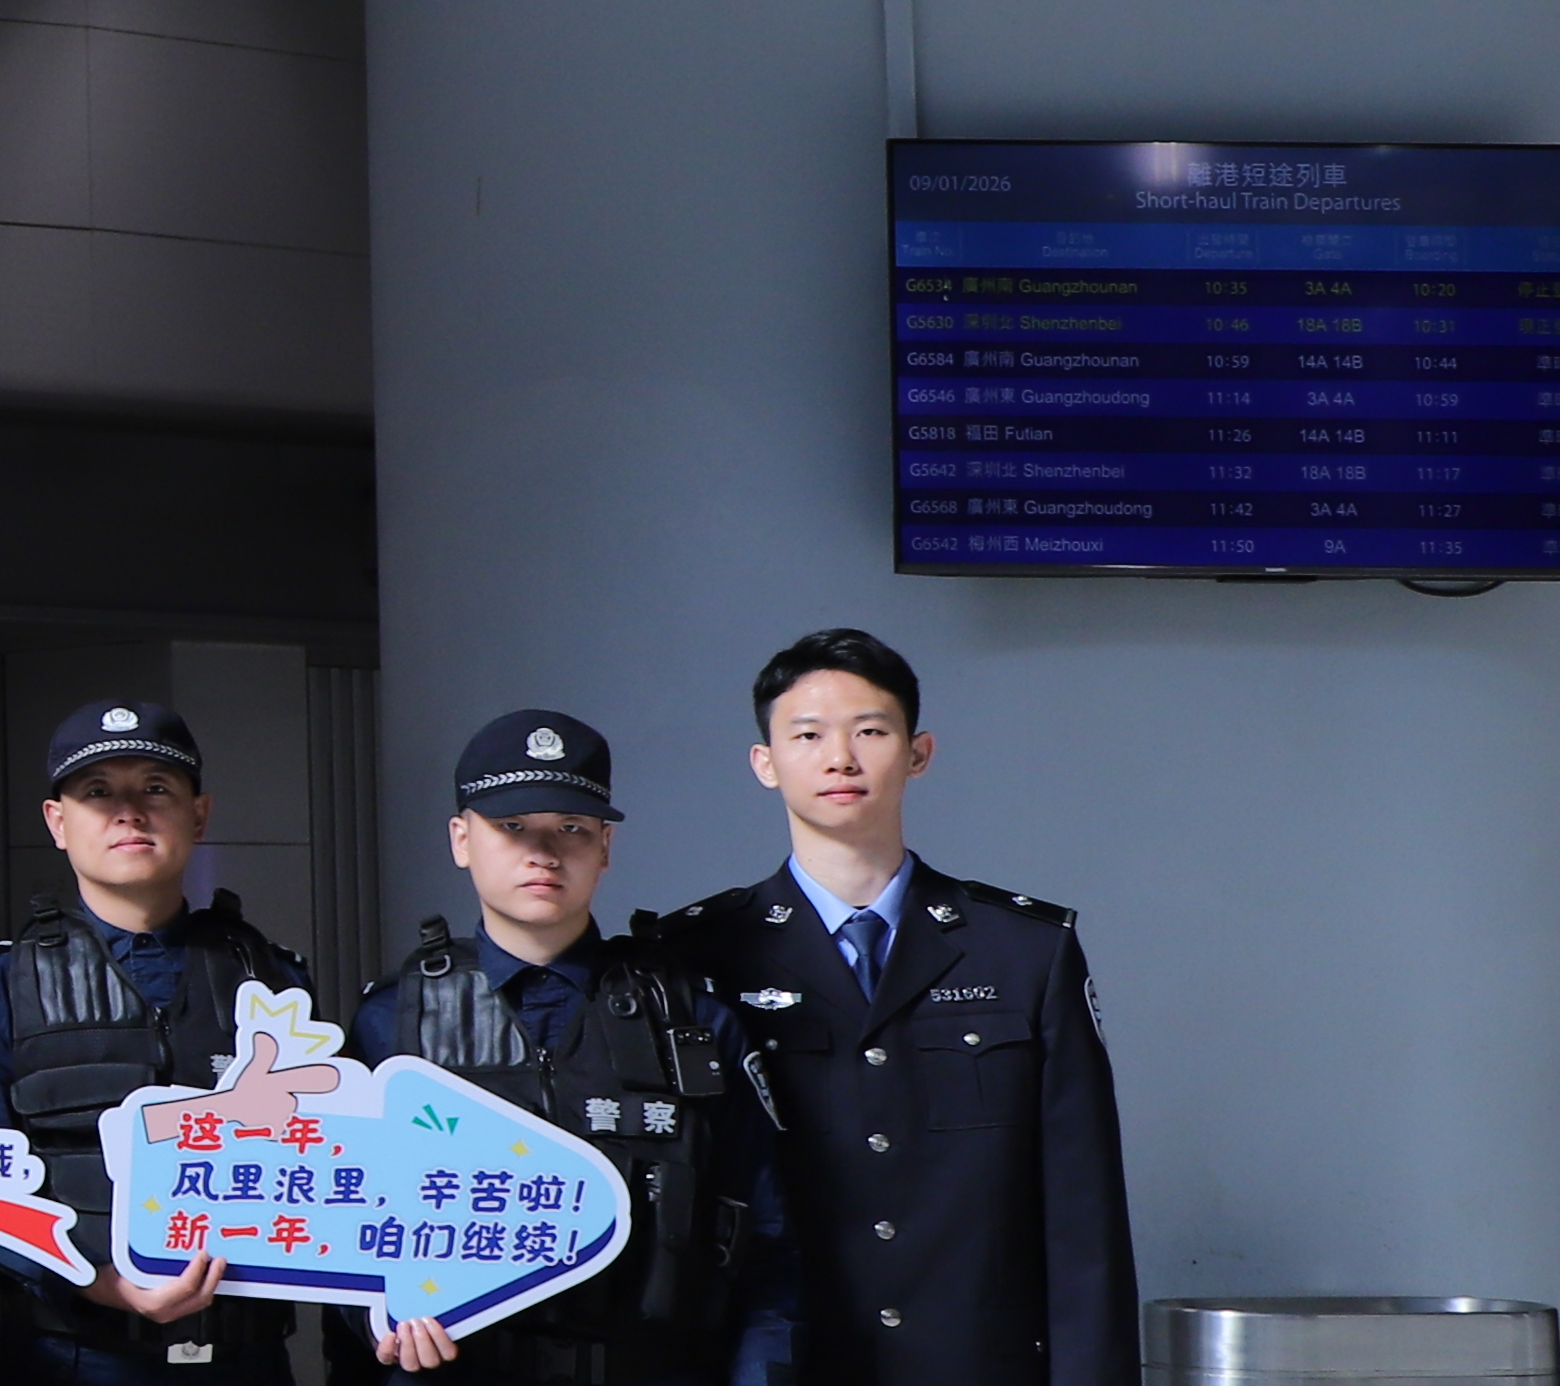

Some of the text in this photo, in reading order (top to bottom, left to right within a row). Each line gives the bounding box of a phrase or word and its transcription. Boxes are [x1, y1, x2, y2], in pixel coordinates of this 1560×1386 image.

[909, 175, 1011, 192] 09/01/2026
[1188, 162, 1347, 188] 離港短途列車
[1136, 191, 1400, 213] Short-haul Train Departures
[1019, 278, 1137, 297] Guangzhounan
[1205, 280, 1248, 296] 10:35
[1304, 281, 1327, 296] 3A
[1330, 281, 1352, 296] 4A
[1413, 283, 1456, 298] 10:20
[1020, 316, 1121, 332] Shenzhenbei
[1206, 317, 1249, 333] 10:46
[1297, 318, 1327, 333] 18A
[1331, 318, 1363, 333] 18B
[1414, 319, 1456, 335] 10:31
[907, 351, 954, 368] G6584
[1021, 352, 1139, 371] Guangzhounan
[1207, 354, 1249, 369] 10:59
[1298, 354, 1328, 370] 14A
[1332, 354, 1363, 370] 14B
[1414, 355, 1458, 371] 10:44
[908, 388, 955, 405] G6546
[1021, 389, 1150, 408] Guangzhoudong
[1207, 391, 1251, 406] 11:14
[1307, 391, 1330, 406] 3A
[1333, 391, 1355, 406] 4A
[1415, 392, 1458, 407] 10:59
[908, 425, 956, 441] G5818
[1005, 425, 1053, 442] Futian
[1208, 428, 1251, 443] 11:26
[1300, 428, 1329, 444] 14A
[1334, 428, 1365, 444] 14B
[1417, 429, 1458, 445] 11:11
[909, 462, 956, 479] G5642
[1023, 463, 1125, 479] Shenzhenbei
[1209, 465, 1252, 480] 11:32
[1301, 465, 1330, 480] 18A
[1335, 465, 1366, 480] 18B
[1418, 466, 1460, 482] 11:17
[910, 499, 958, 515] G6568
[1024, 499, 1153, 519] Guangzhoudong
[1210, 502, 1253, 517] 11:42
[1311, 502, 1333, 517] 3A
[1336, 502, 1358, 517] 4A
[1419, 503, 1462, 518] 11:27
[911, 536, 959, 552] G6542
[1025, 536, 1104, 554] Meizhouxi
[1211, 539, 1254, 554] 11:50
[1324, 539, 1346, 554] 9A
[1420, 540, 1463, 555] 11:35
[584, 1097, 677, 1136] 警察
[176, 1113, 345, 1158] 这一年，
[170, 1164, 588, 1215] 风里浪里，辛苦啦！
[165, 1210, 581, 1266] 新一年，咱们继续！
